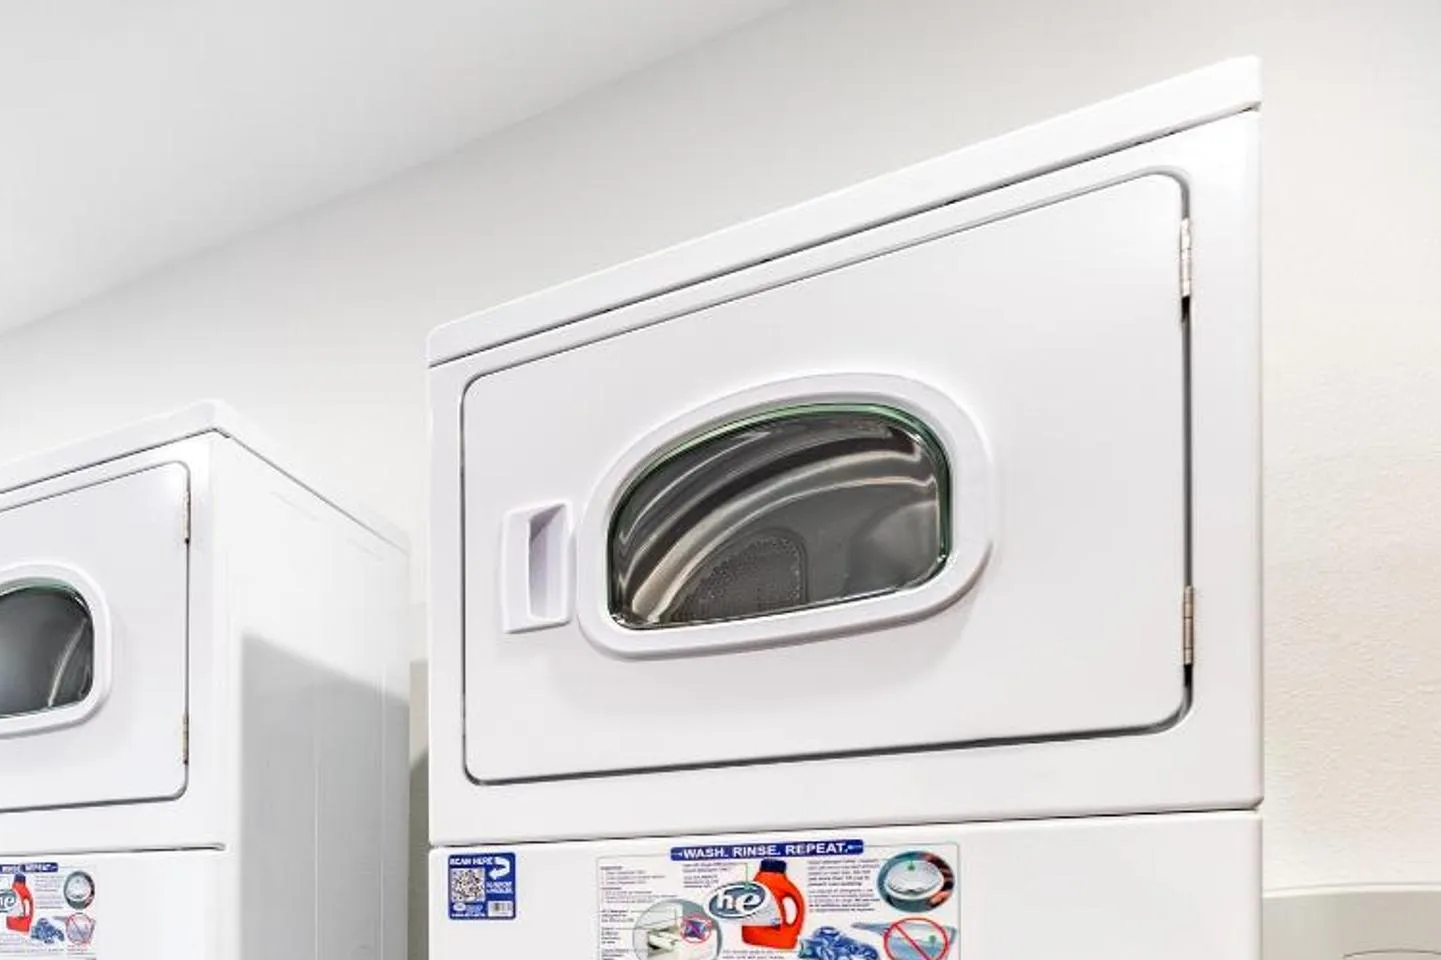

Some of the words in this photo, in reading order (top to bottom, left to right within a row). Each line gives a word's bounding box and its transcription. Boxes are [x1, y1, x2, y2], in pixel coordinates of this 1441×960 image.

[683, 848, 729, 859] WASH.
[733, 846, 781, 857] RINSE.
[718, 887, 760, 912] he
